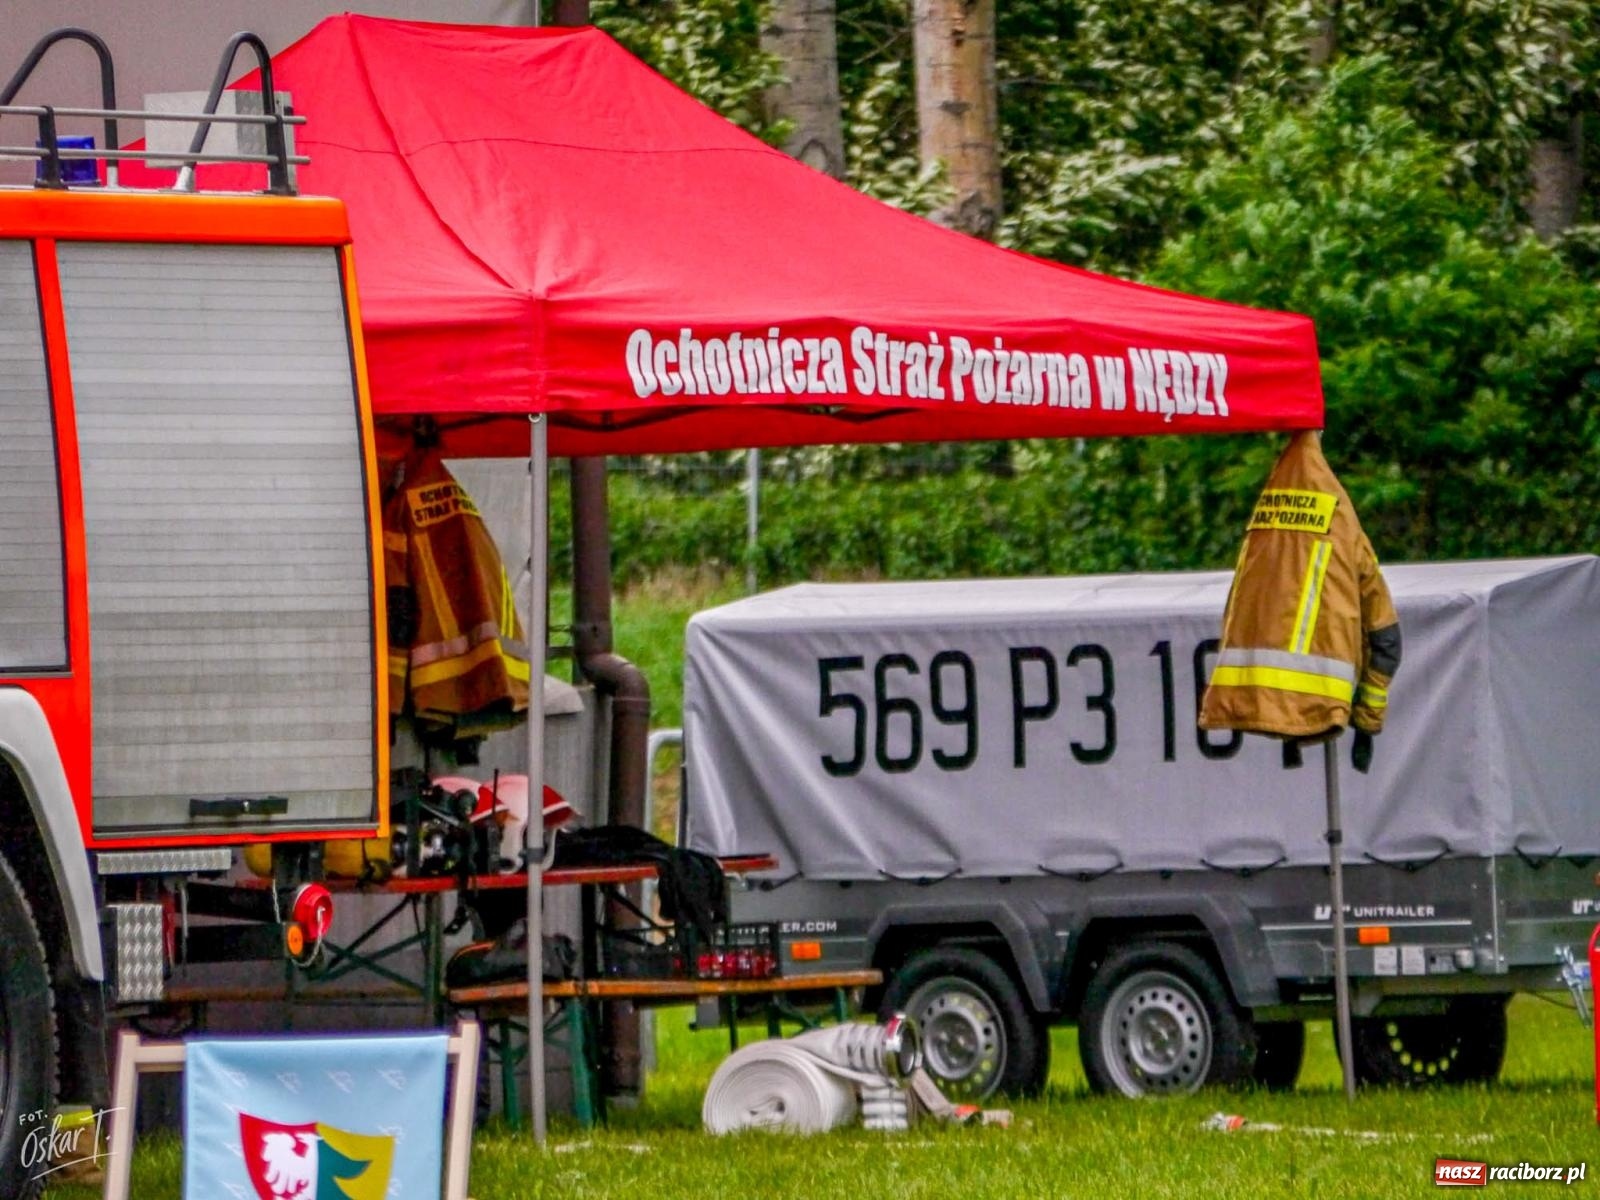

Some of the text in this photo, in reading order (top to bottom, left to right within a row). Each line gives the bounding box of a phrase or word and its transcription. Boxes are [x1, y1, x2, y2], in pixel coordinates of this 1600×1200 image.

[624, 325, 1230, 422] Ochotnicza Straż Pożarna w NĘDZY
[818, 650, 979, 777] 569
[1009, 643, 1118, 769] P3
[779, 921, 837, 933] ER.COM
[1353, 904, 1436, 918] UNITRAILER
